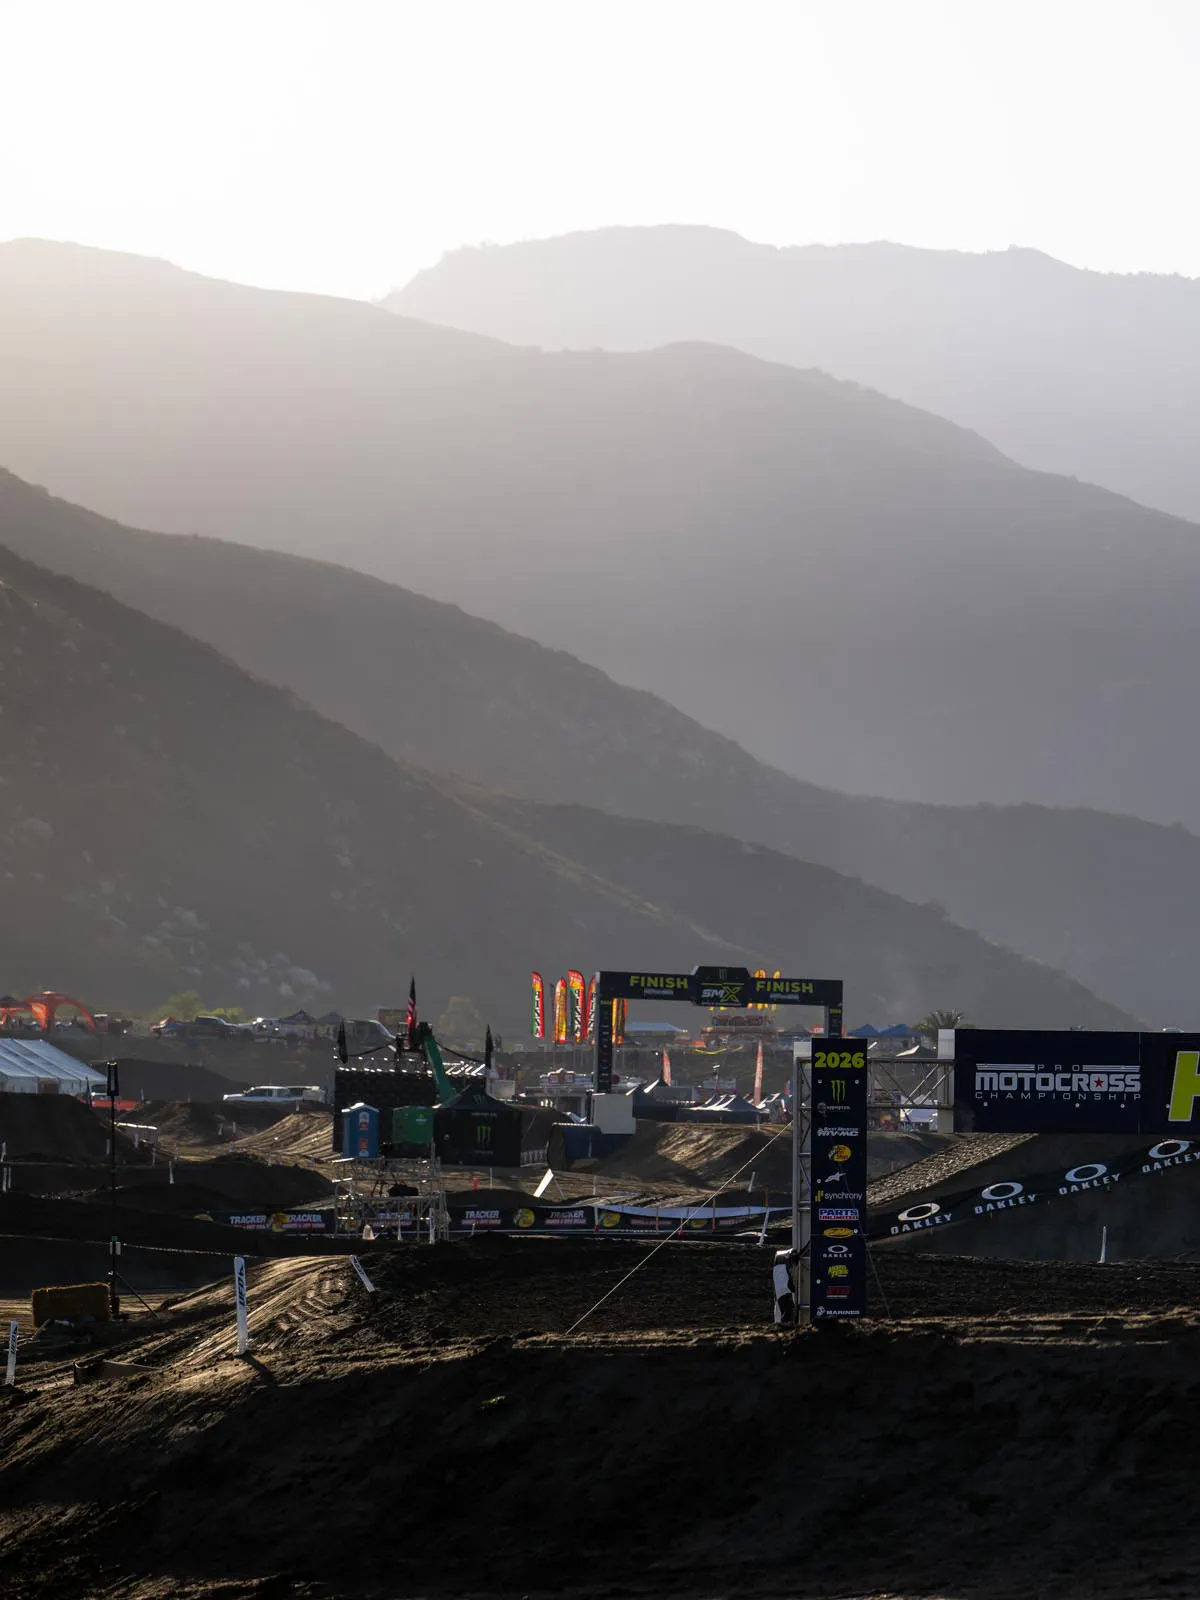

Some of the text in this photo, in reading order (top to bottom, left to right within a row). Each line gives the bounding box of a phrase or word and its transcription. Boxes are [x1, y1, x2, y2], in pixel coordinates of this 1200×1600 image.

[629, 975, 689, 990] FINISH
[755, 980, 815, 994] FINISH
[701, 985, 740, 1002] SMX
[814, 1051, 865, 1069] 2026
[1037, 1064, 1081, 1072] PRO
[975, 1072, 1142, 1092] MOTOCROSS
[975, 1092, 1142, 1101] CHAMPIONSHIP
[1058, 1172, 1121, 1195] OAKLEY
[824, 1191, 863, 1201] synchrony
[974, 1193, 1037, 1215] OAKLEY
[229, 1215, 267, 1225] TRACKER
[465, 1210, 500, 1219] TRACKER
[550, 1209, 585, 1219] TRACKER
[890, 1212, 952, 1236] OAKLEY
